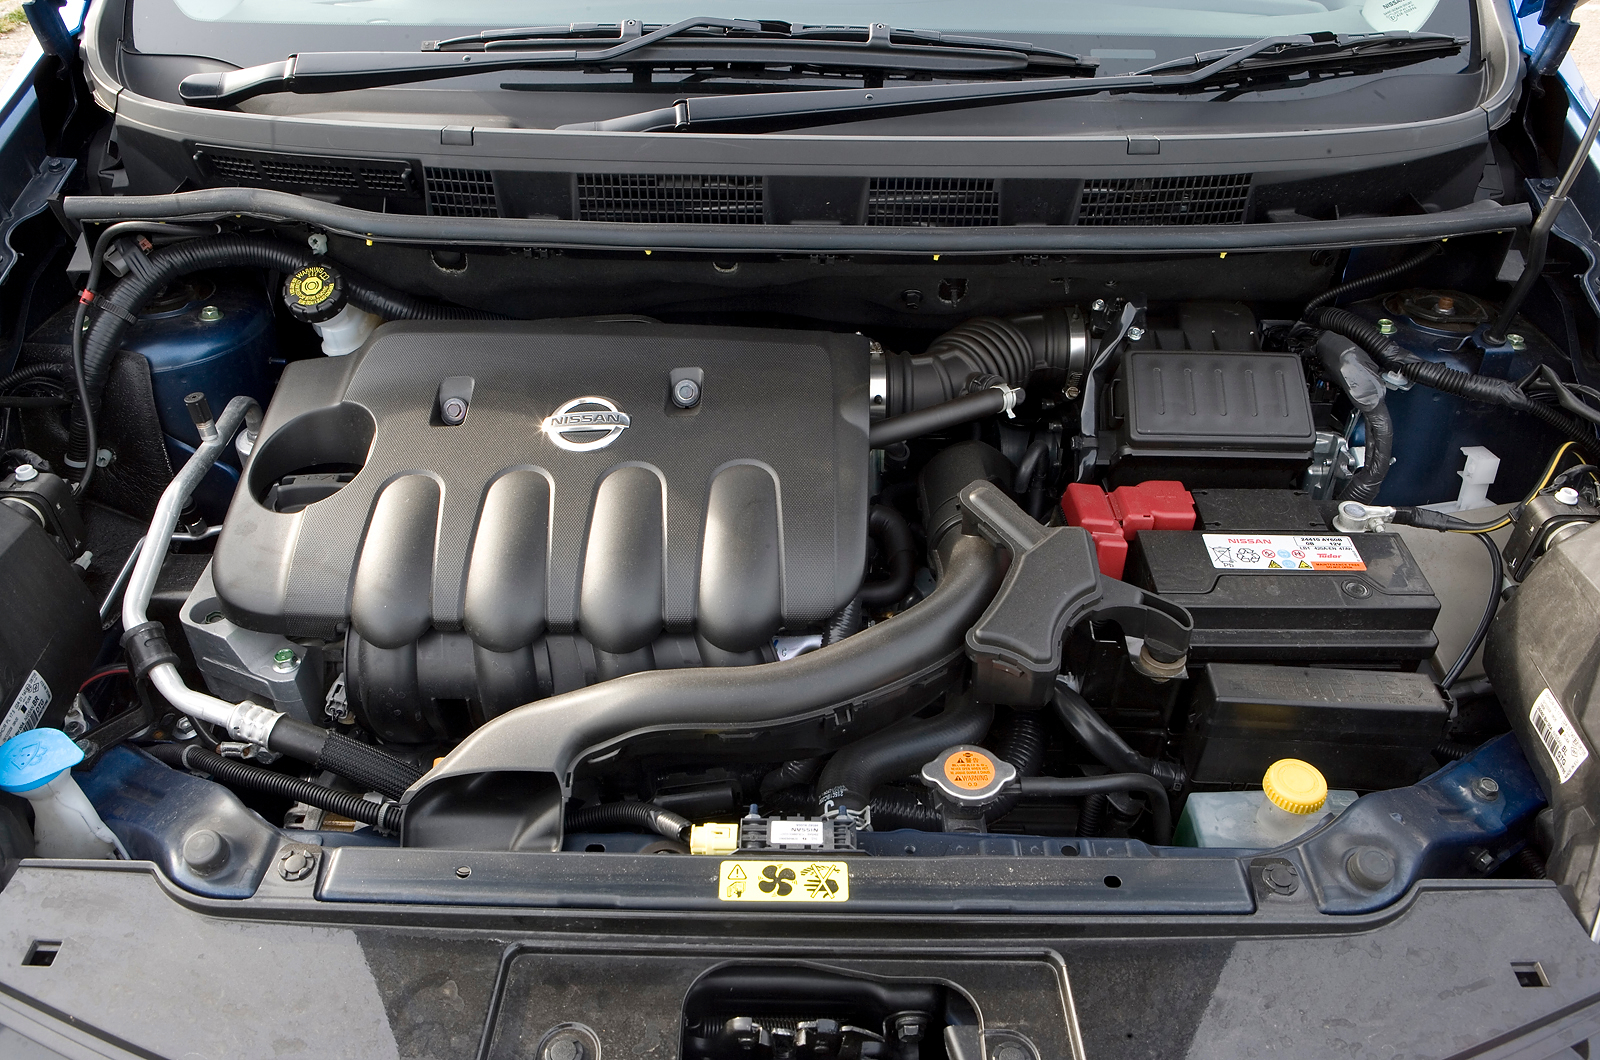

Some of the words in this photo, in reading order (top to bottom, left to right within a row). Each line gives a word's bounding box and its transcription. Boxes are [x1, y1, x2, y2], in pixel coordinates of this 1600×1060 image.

[296, 267, 324, 278] WARNING
[551, 414, 620, 426] NISSAN
[32, 695, 40, 706] BR
[1561, 745, 1568, 756] BL
[1558, 751, 1566, 765] GTG
